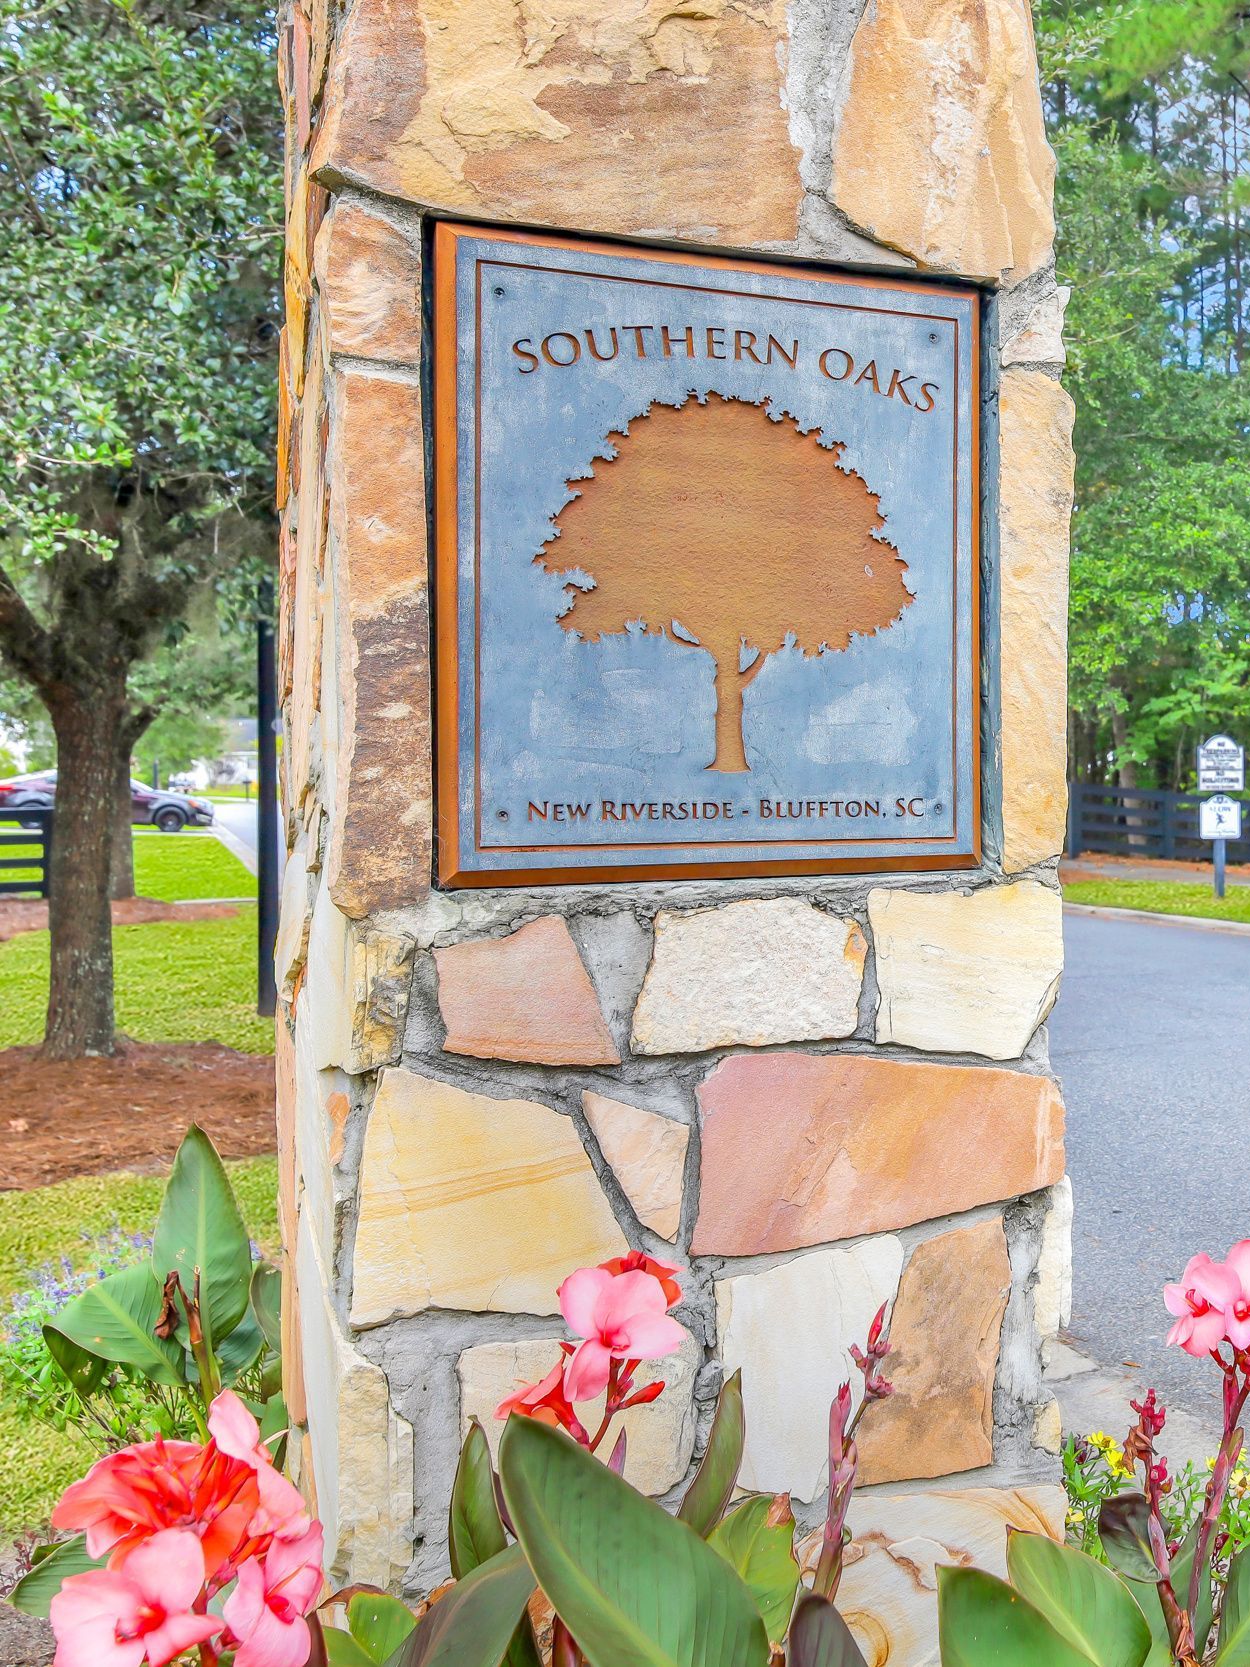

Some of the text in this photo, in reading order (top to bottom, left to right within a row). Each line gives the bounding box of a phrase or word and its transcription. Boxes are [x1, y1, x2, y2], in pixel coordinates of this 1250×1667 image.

[511, 325, 940, 413] SOUTHERN OAKS
[895, 797, 925, 818] SC
